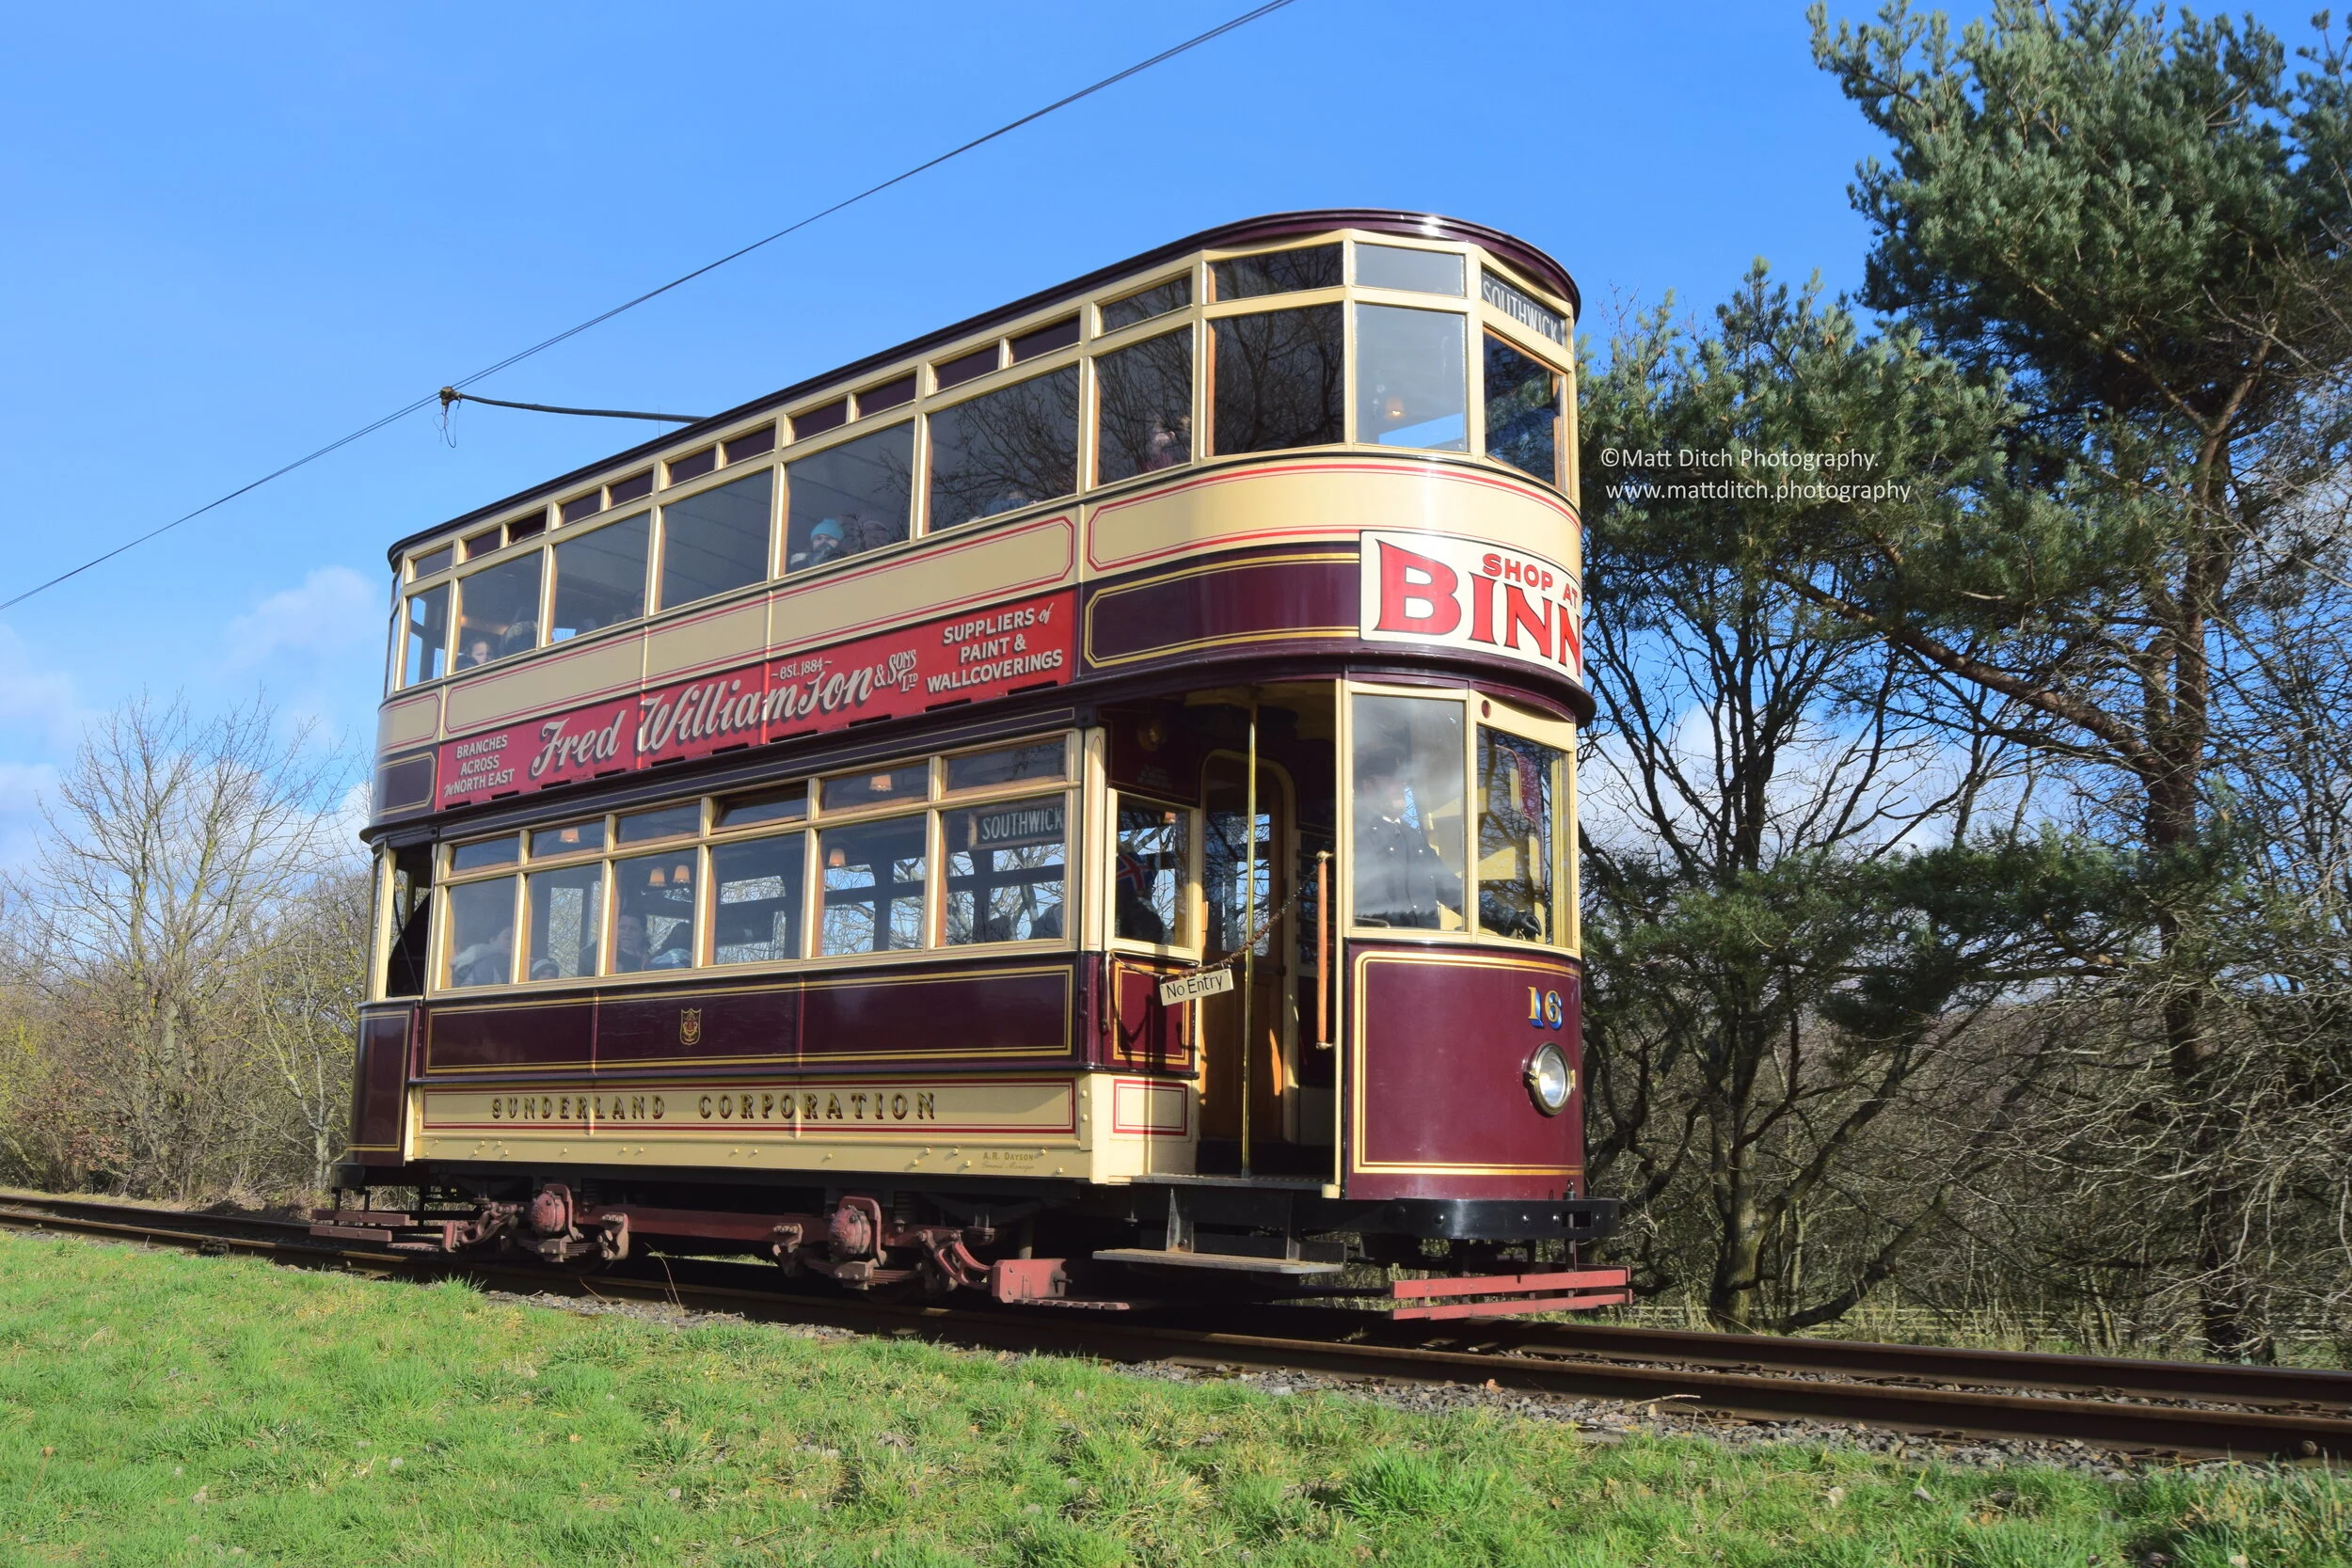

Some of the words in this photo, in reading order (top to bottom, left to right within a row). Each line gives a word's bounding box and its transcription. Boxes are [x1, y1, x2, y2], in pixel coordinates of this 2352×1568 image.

[1483, 280, 1558, 343] SOUTHWICK
[1482, 553, 1553, 591] SHOP
[1562, 582, 1579, 609] AT
[944, 608, 1035, 644] SUPPLIERS
[1039, 602, 1054, 625] of
[961, 637, 1009, 663] PAINT
[1013, 633, 1026, 652] &
[927, 649, 1063, 693] WALLCOVERINGS
[532, 708, 627, 777] Fred
[638, 666, 874, 753] Williamson
[874, 664, 886, 688] &
[456, 734, 508, 760] BRANCHES
[453, 774, 486, 795] NORTH
[488, 768, 515, 787] EAST
[460, 754, 500, 777] ACROSS
[981, 807, 1063, 840] SOUTHWICK
[1166, 983, 1185, 1000] No
[1186, 974, 1224, 995] Entry
[1527, 986, 1563, 1030] 16
[491, 1094, 665, 1120] SUNDERLAND
[697, 1092, 935, 1120] CORPORATION
